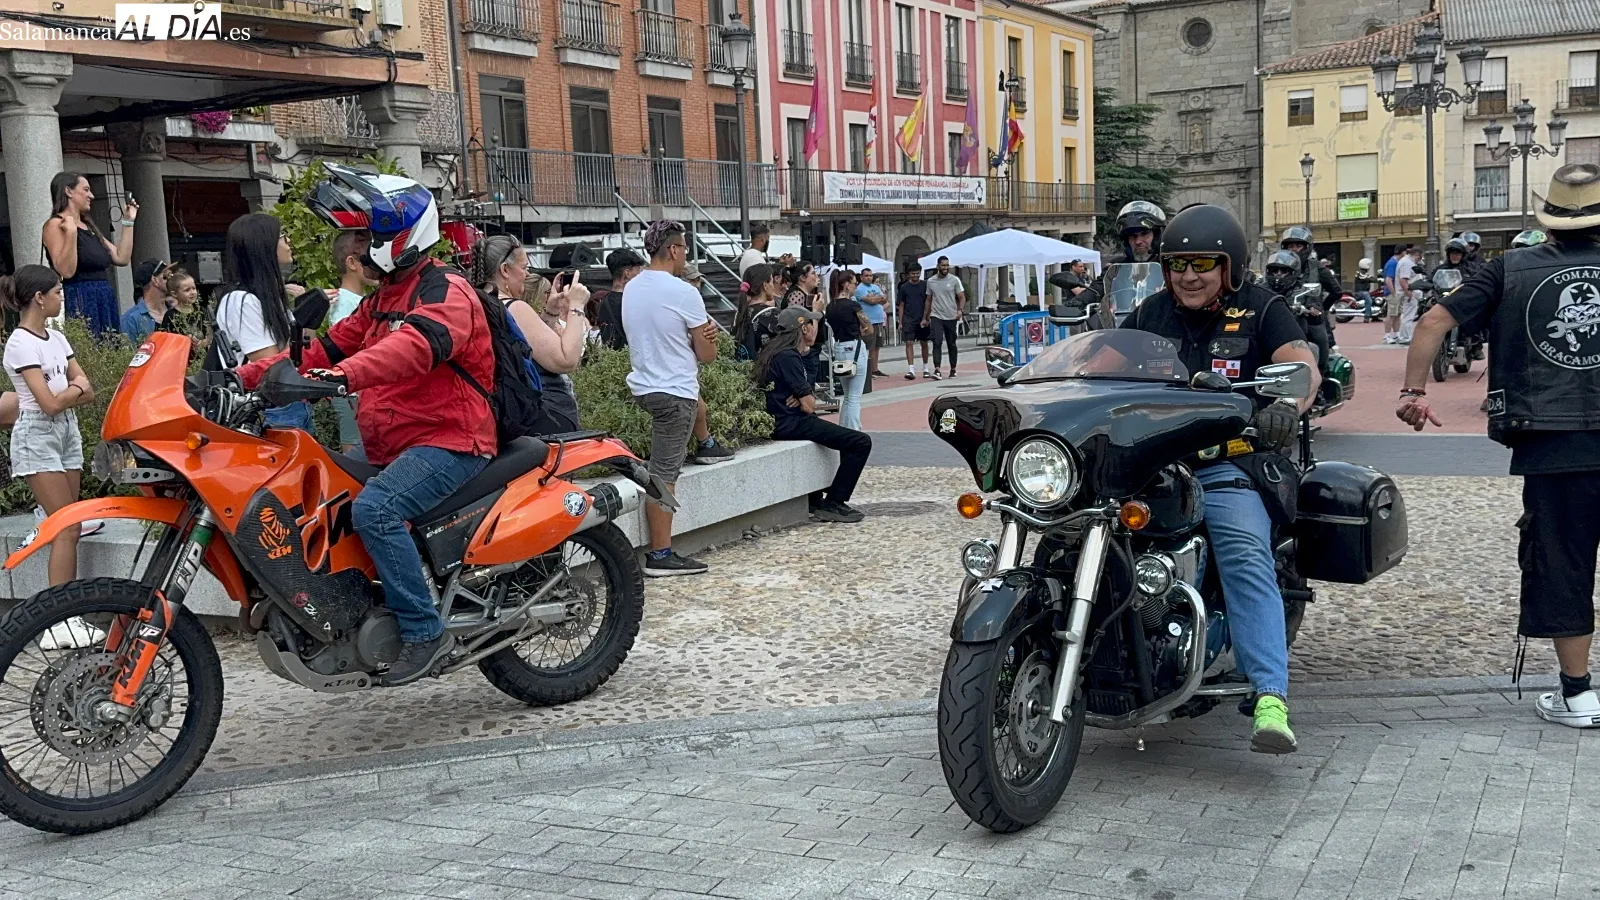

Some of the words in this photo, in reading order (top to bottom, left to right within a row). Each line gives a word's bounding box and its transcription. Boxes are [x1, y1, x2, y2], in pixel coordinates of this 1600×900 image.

[952, 181, 969, 189] COMRCA
[1553, 270, 1600, 285] COMAN
[324, 679, 357, 688] KTM
